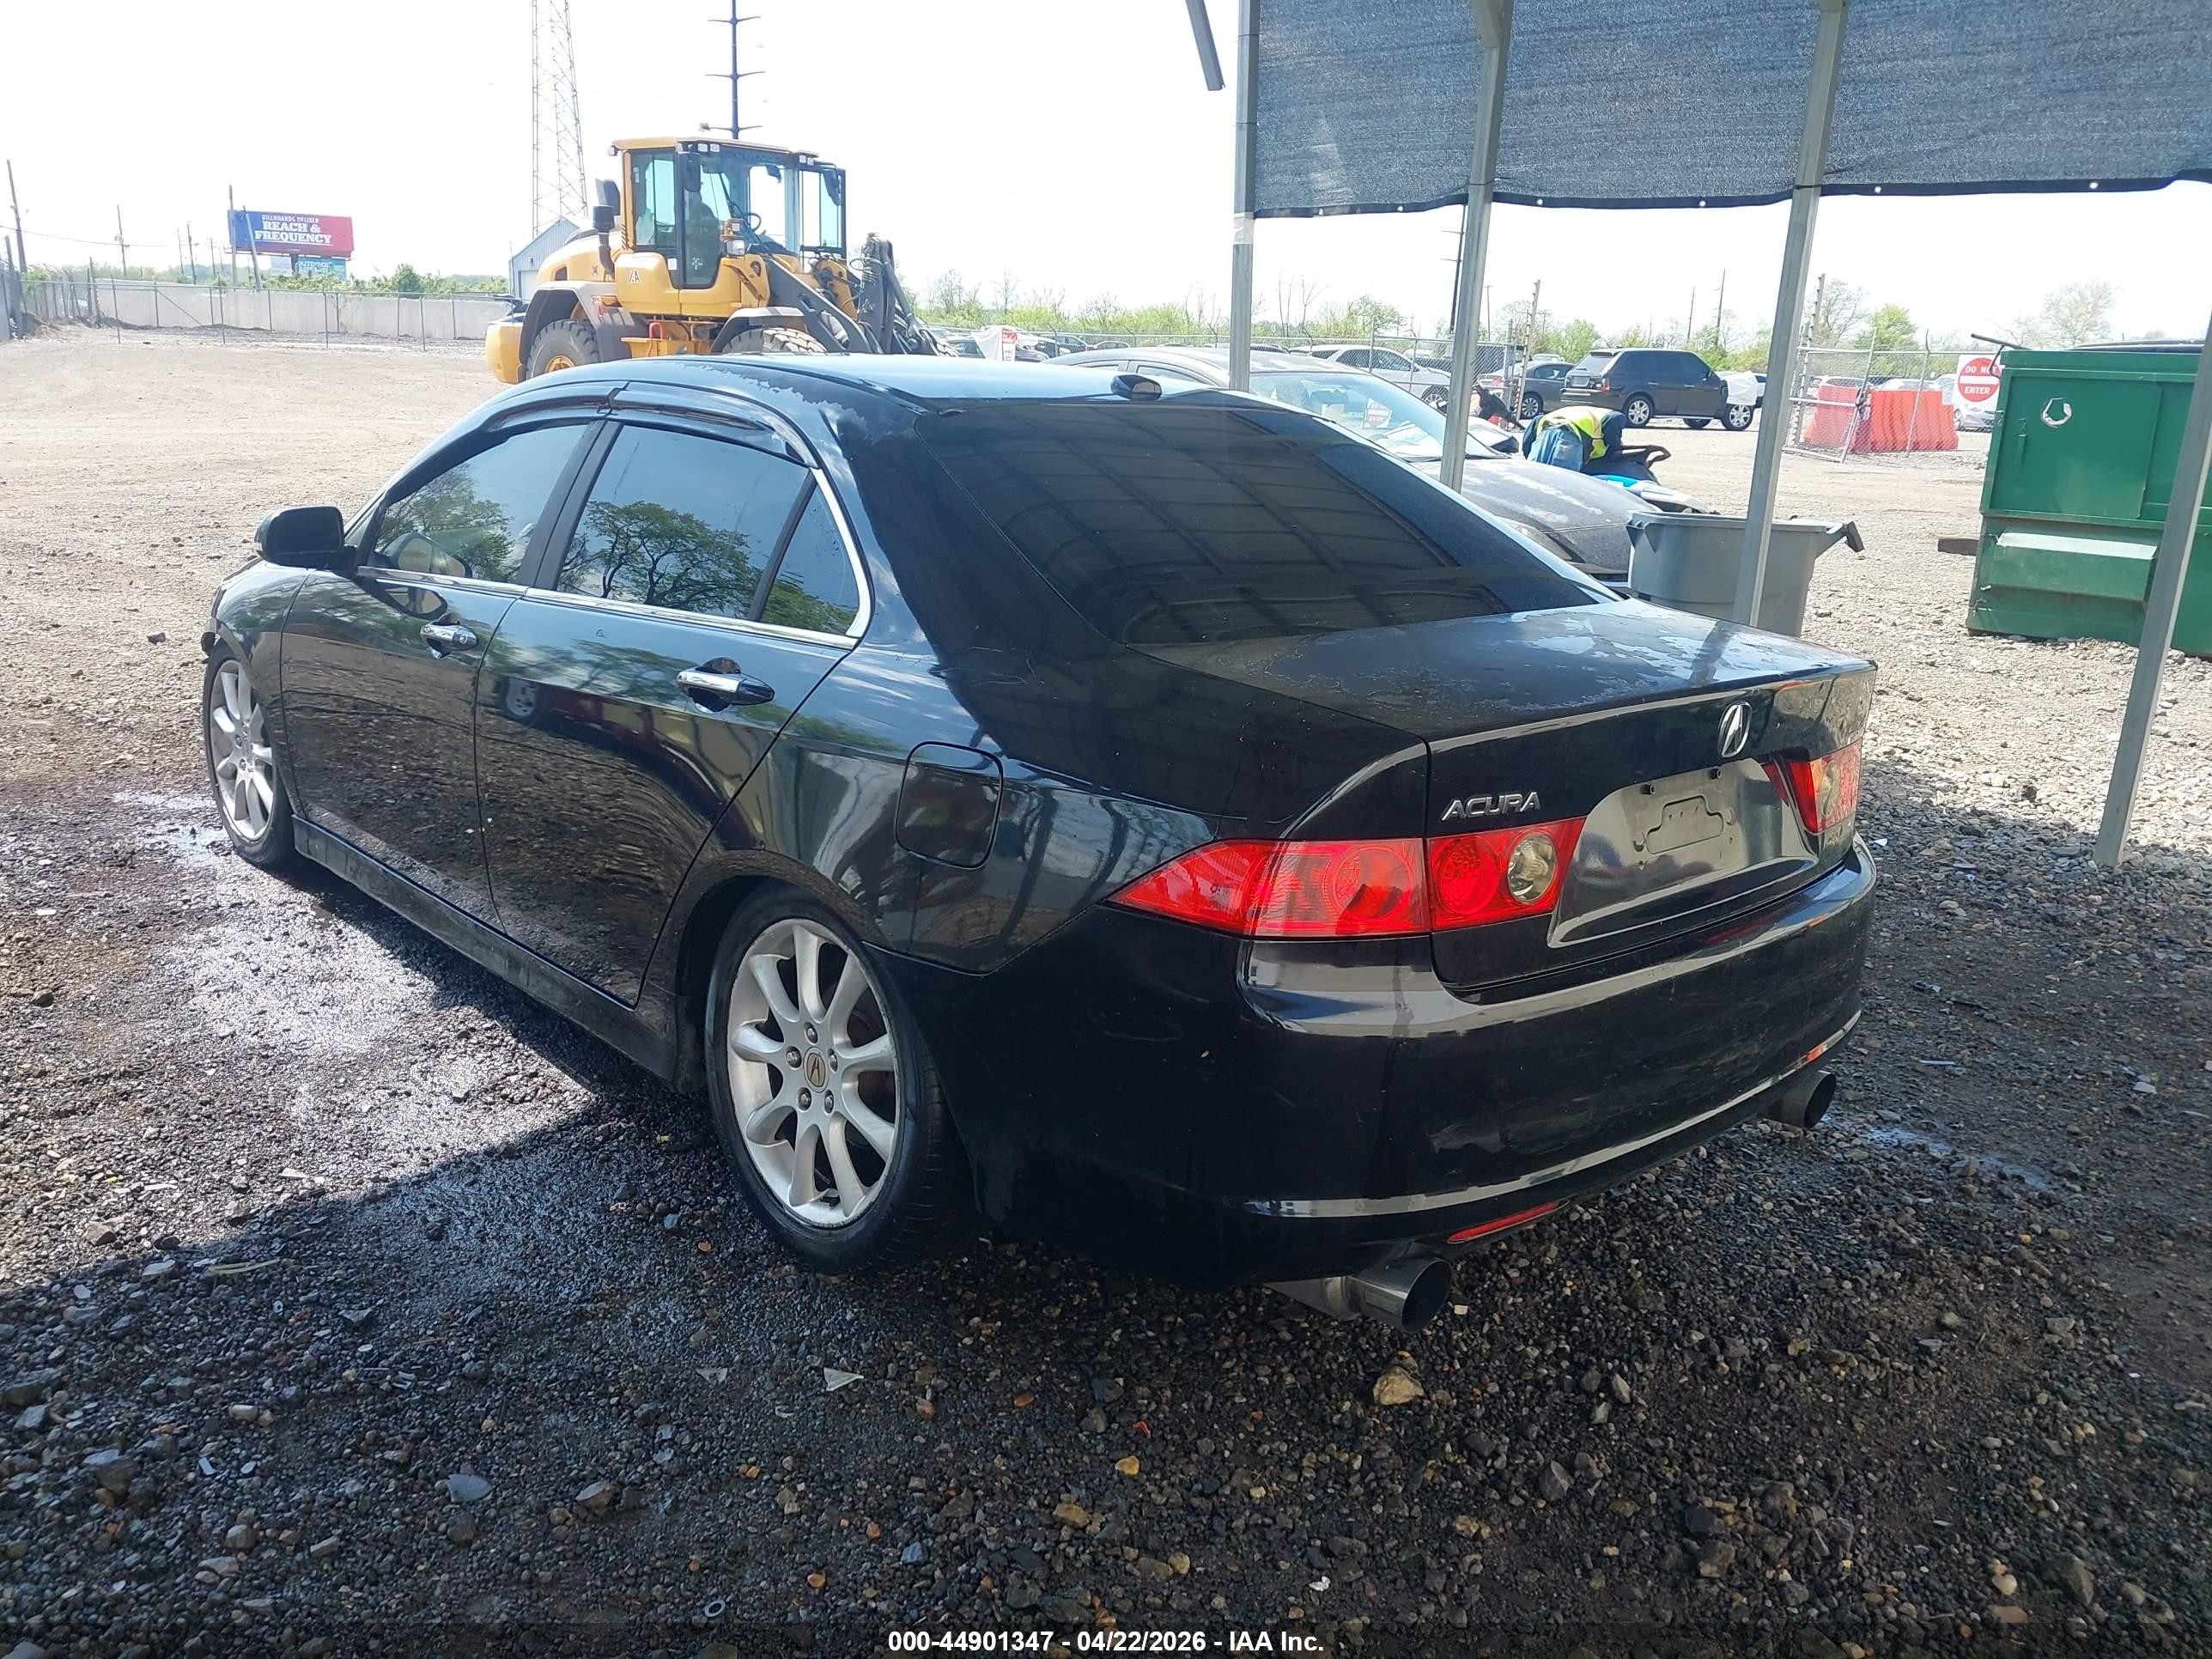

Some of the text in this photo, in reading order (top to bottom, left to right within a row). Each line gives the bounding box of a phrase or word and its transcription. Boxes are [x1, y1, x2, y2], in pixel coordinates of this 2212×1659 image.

[262, 221, 321, 233] REACH &
[254, 230, 332, 243] FREQUENCY
[1441, 792, 1540, 820] ACURA
